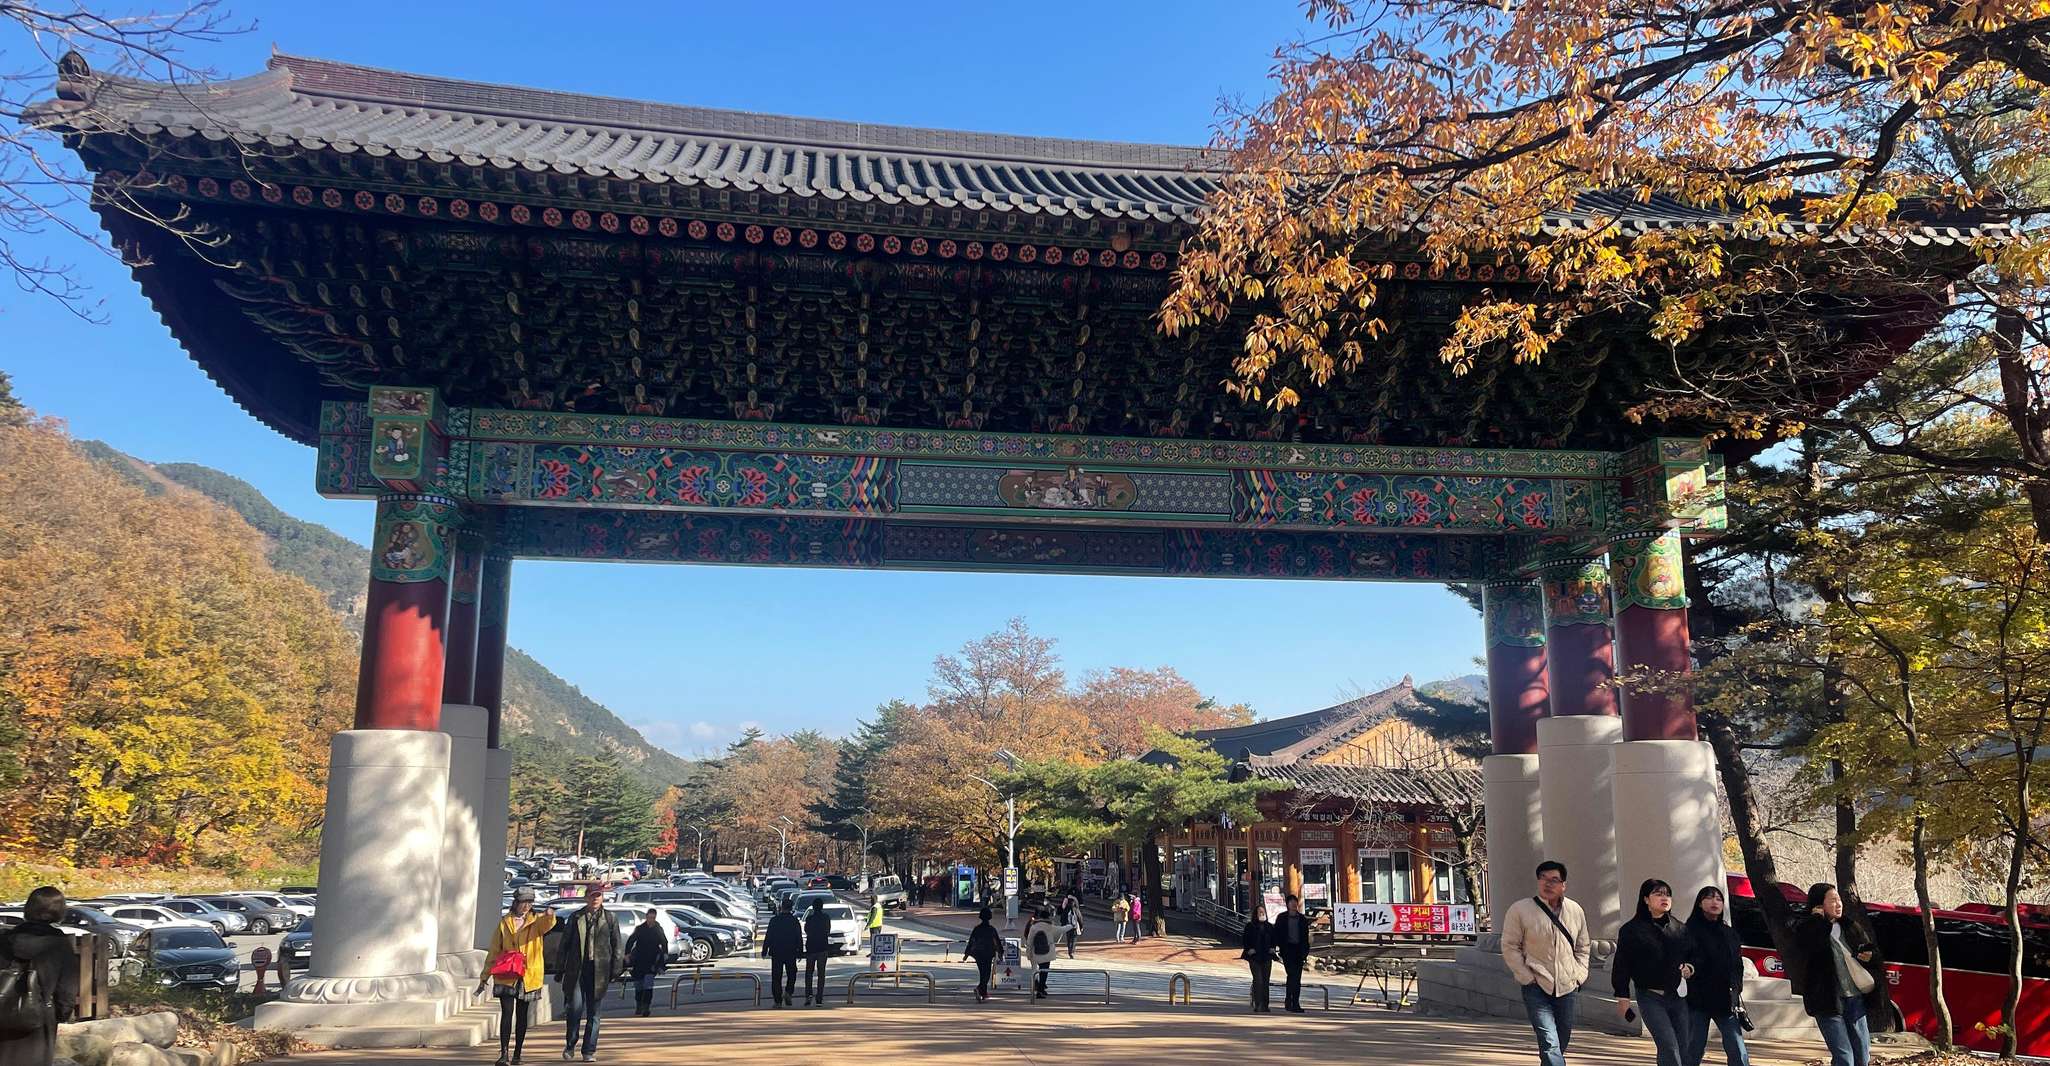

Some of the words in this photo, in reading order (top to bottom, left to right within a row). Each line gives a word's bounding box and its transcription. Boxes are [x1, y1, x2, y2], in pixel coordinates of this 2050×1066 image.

[1412, 907, 1430, 916] 커피
[1349, 908, 1391, 928] 휴게소
[1413, 921, 1430, 931] 분식
[1451, 922, 1474, 931] 화장실
